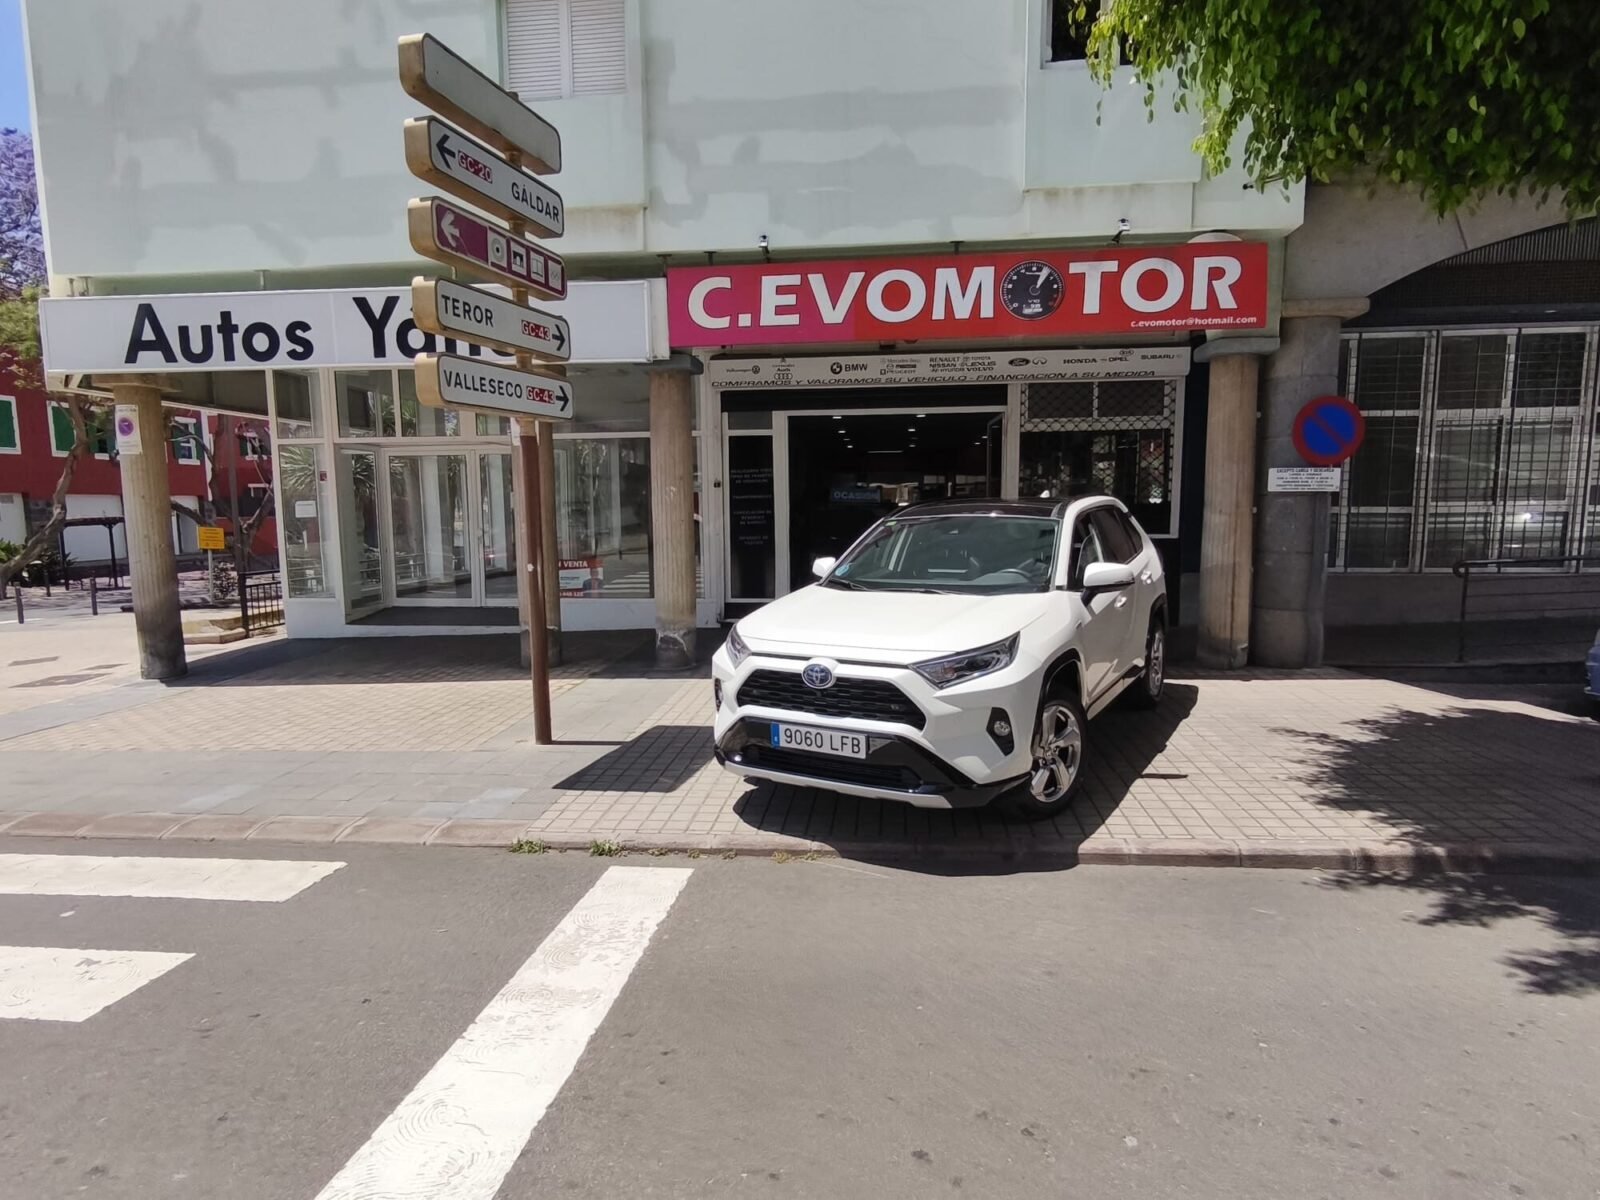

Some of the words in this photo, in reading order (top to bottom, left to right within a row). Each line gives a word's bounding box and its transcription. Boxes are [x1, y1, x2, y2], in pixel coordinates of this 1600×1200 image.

[459, 152, 492, 183] GC-20
[512, 182, 560, 222] GÁLDAR
[441, 294, 494, 328] TEROR
[522, 321, 551, 342] GC-43
[1130, 316, 1257, 328] c.evomotor@hotmail.com
[124, 303, 314, 364] Autos
[806, 377, 882, 385] VALORAMOS
[906, 375, 968, 383] VEHICULO
[976, 372, 1067, 382] FINANCIACION
[1104, 370, 1156, 378] MEDIDA
[844, 363, 868, 372] BMW
[443, 369, 523, 399] VALLESECO
[527, 387, 556, 404] GC-43
[563, 560, 589, 568] VENTA
[784, 728, 824, 749] 9060
[830, 735, 861, 755] LFB
